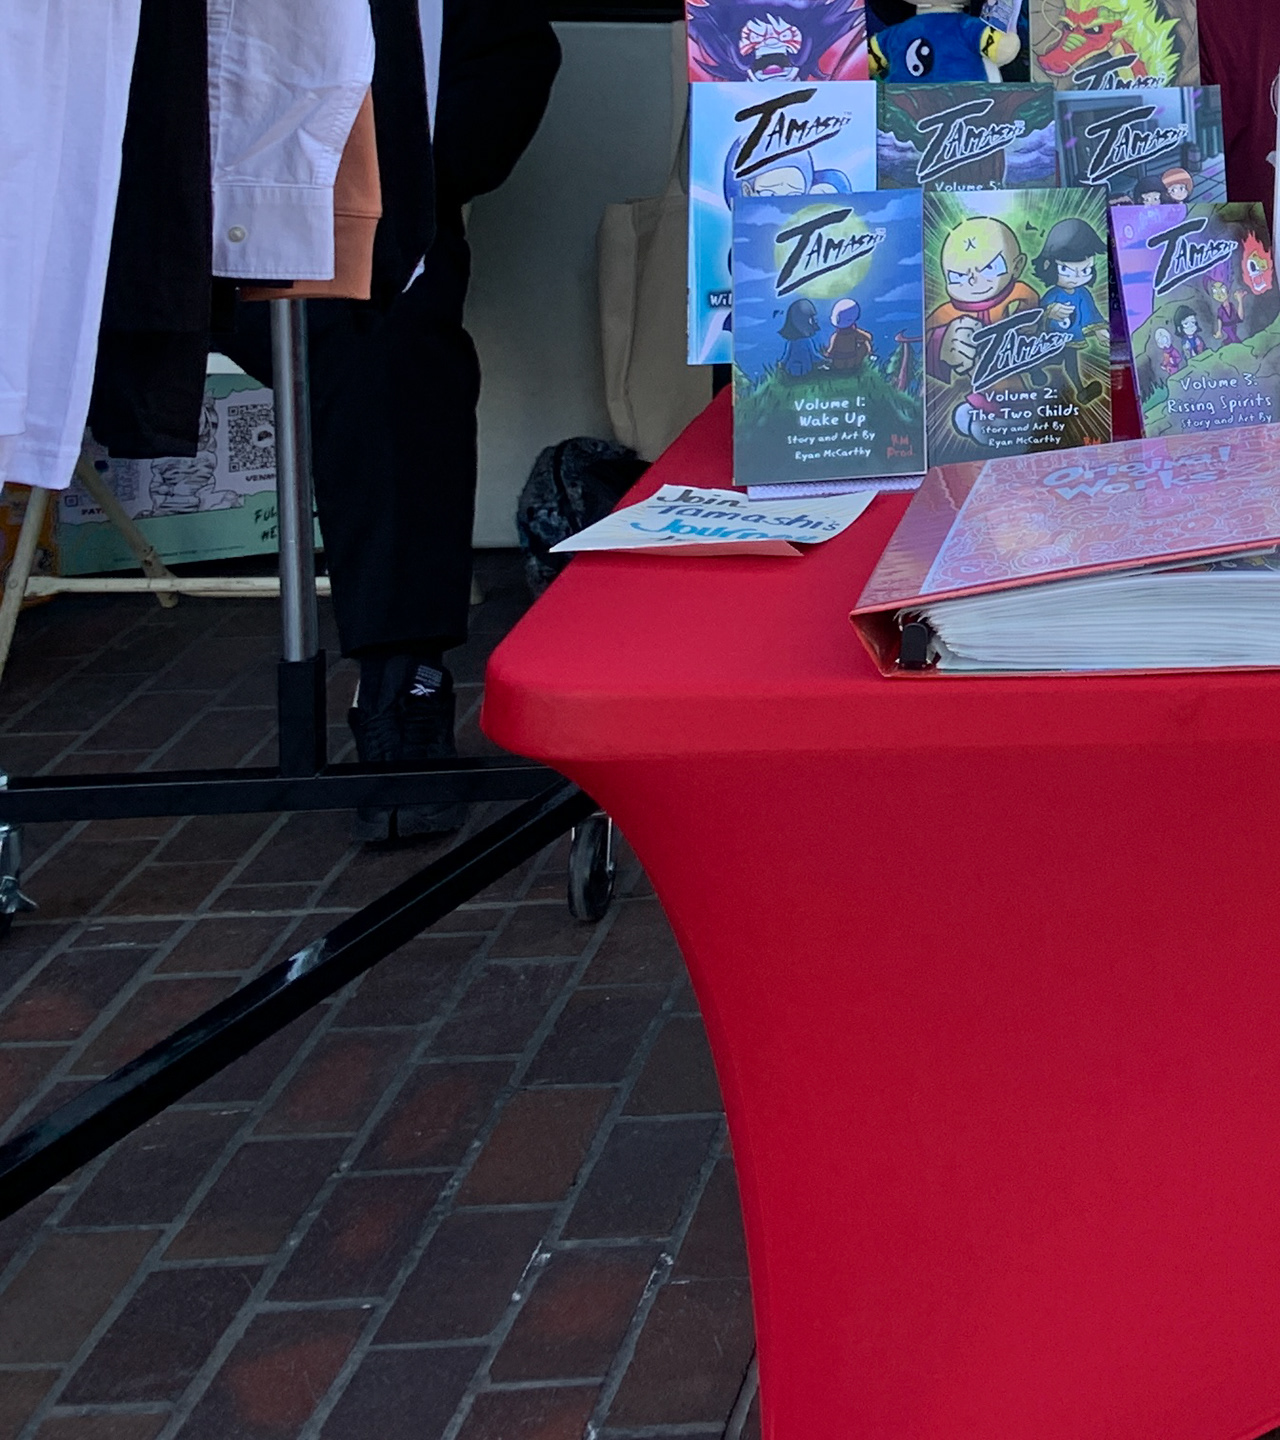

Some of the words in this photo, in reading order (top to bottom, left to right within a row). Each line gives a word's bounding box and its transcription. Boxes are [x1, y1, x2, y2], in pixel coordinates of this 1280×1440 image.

[732, 88, 851, 180] TAMASHI
[935, 182, 983, 191] Volume
[776, 209, 886, 297] TAMASHI
[1146, 217, 1238, 297] TAMASHI
[1180, 377, 1237, 390] Volume
[1243, 373, 1258, 386] 3:
[985, 390, 1037, 402] Volume
[1043, 388, 1058, 399] 2:
[794, 398, 849, 411] Volume
[968, 409, 995, 420] The
[1000, 408, 1032, 418] Two
[1037, 404, 1079, 417] Childs
[1168, 398, 1215, 414] Rising
[1220, 394, 1271, 413] Spirits
[800, 413, 839, 426] Wake
[845, 412, 866, 427] Up
[1182, 419, 1211, 429] Story
[1214, 415, 1234, 425] and
[1238, 414, 1254, 423] Art
[1259, 412, 1272, 423] By
[981, 426, 1007, 435] Story
[1010, 424, 1029, 432] and
[1032, 422, 1049, 430] Art
[1052, 421, 1065, 431] By
[787, 435, 815, 445] Story
[818, 432, 838, 442] and
[841, 431, 858, 440] Art
[862, 430, 876, 441] By
[989, 438, 1013, 448] Ryan
[1016, 436, 1061, 445] McCarthy
[795, 450, 820, 462] Ryan
[823, 447, 871, 458] McCarthy
[1054, 469, 1221, 500] Works
[656, 489, 748, 509] Join
[647, 505, 840, 532] Tamashi's
